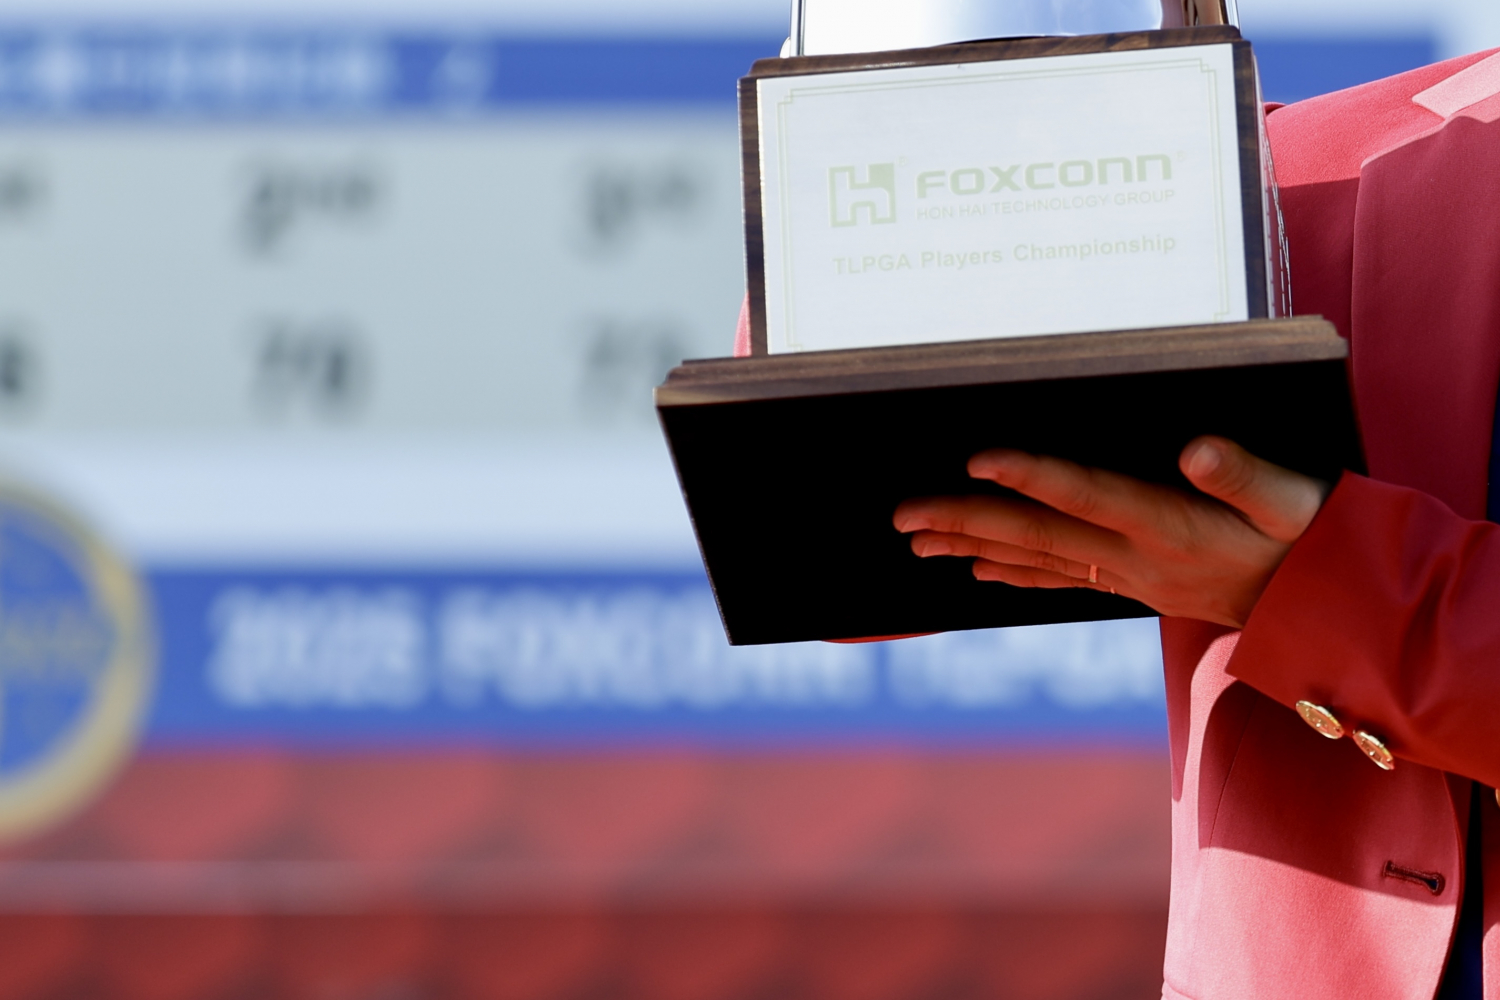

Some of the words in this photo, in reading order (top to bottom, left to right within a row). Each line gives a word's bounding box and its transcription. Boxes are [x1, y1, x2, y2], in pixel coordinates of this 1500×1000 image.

[915, 153, 1174, 200] FOXCONN
[915, 204, 953, 221] HON
[958, 202, 987, 218] HAI
[991, 193, 1109, 215] TECHNOLOGY
[1112, 188, 1176, 207] GROUP
[832, 253, 912, 276] TLPGA
[919, 248, 1004, 271] Players
[1013, 233, 1177, 262] Championship
